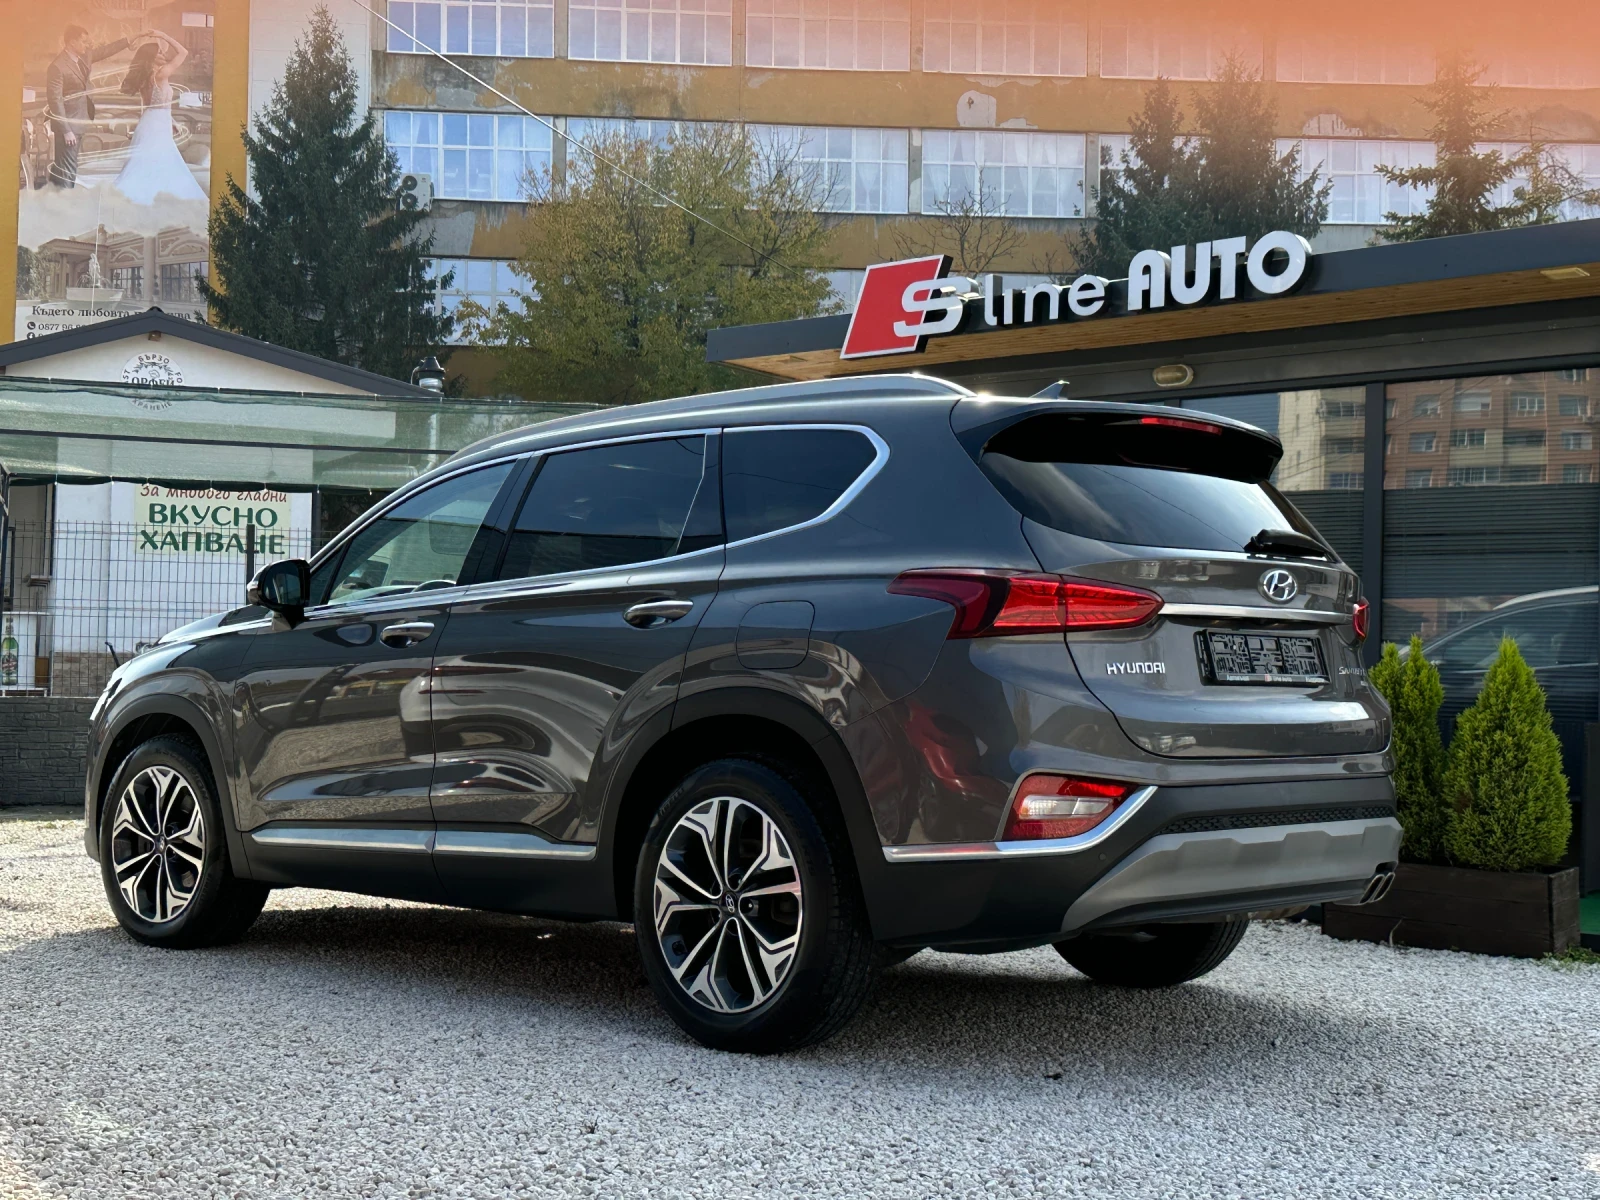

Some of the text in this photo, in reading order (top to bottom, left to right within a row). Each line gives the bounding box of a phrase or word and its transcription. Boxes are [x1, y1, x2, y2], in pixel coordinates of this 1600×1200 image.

[893, 230, 1308, 337] S line AUTO
[32, 305, 75, 317] Където
[78, 307, 130, 318] любовта
[38, 323, 60, 331] 0877
[140, 484, 160, 497] За
[148, 503, 278, 528] ВКУСНО
[1106, 662, 1166, 675] HYUNDAI
